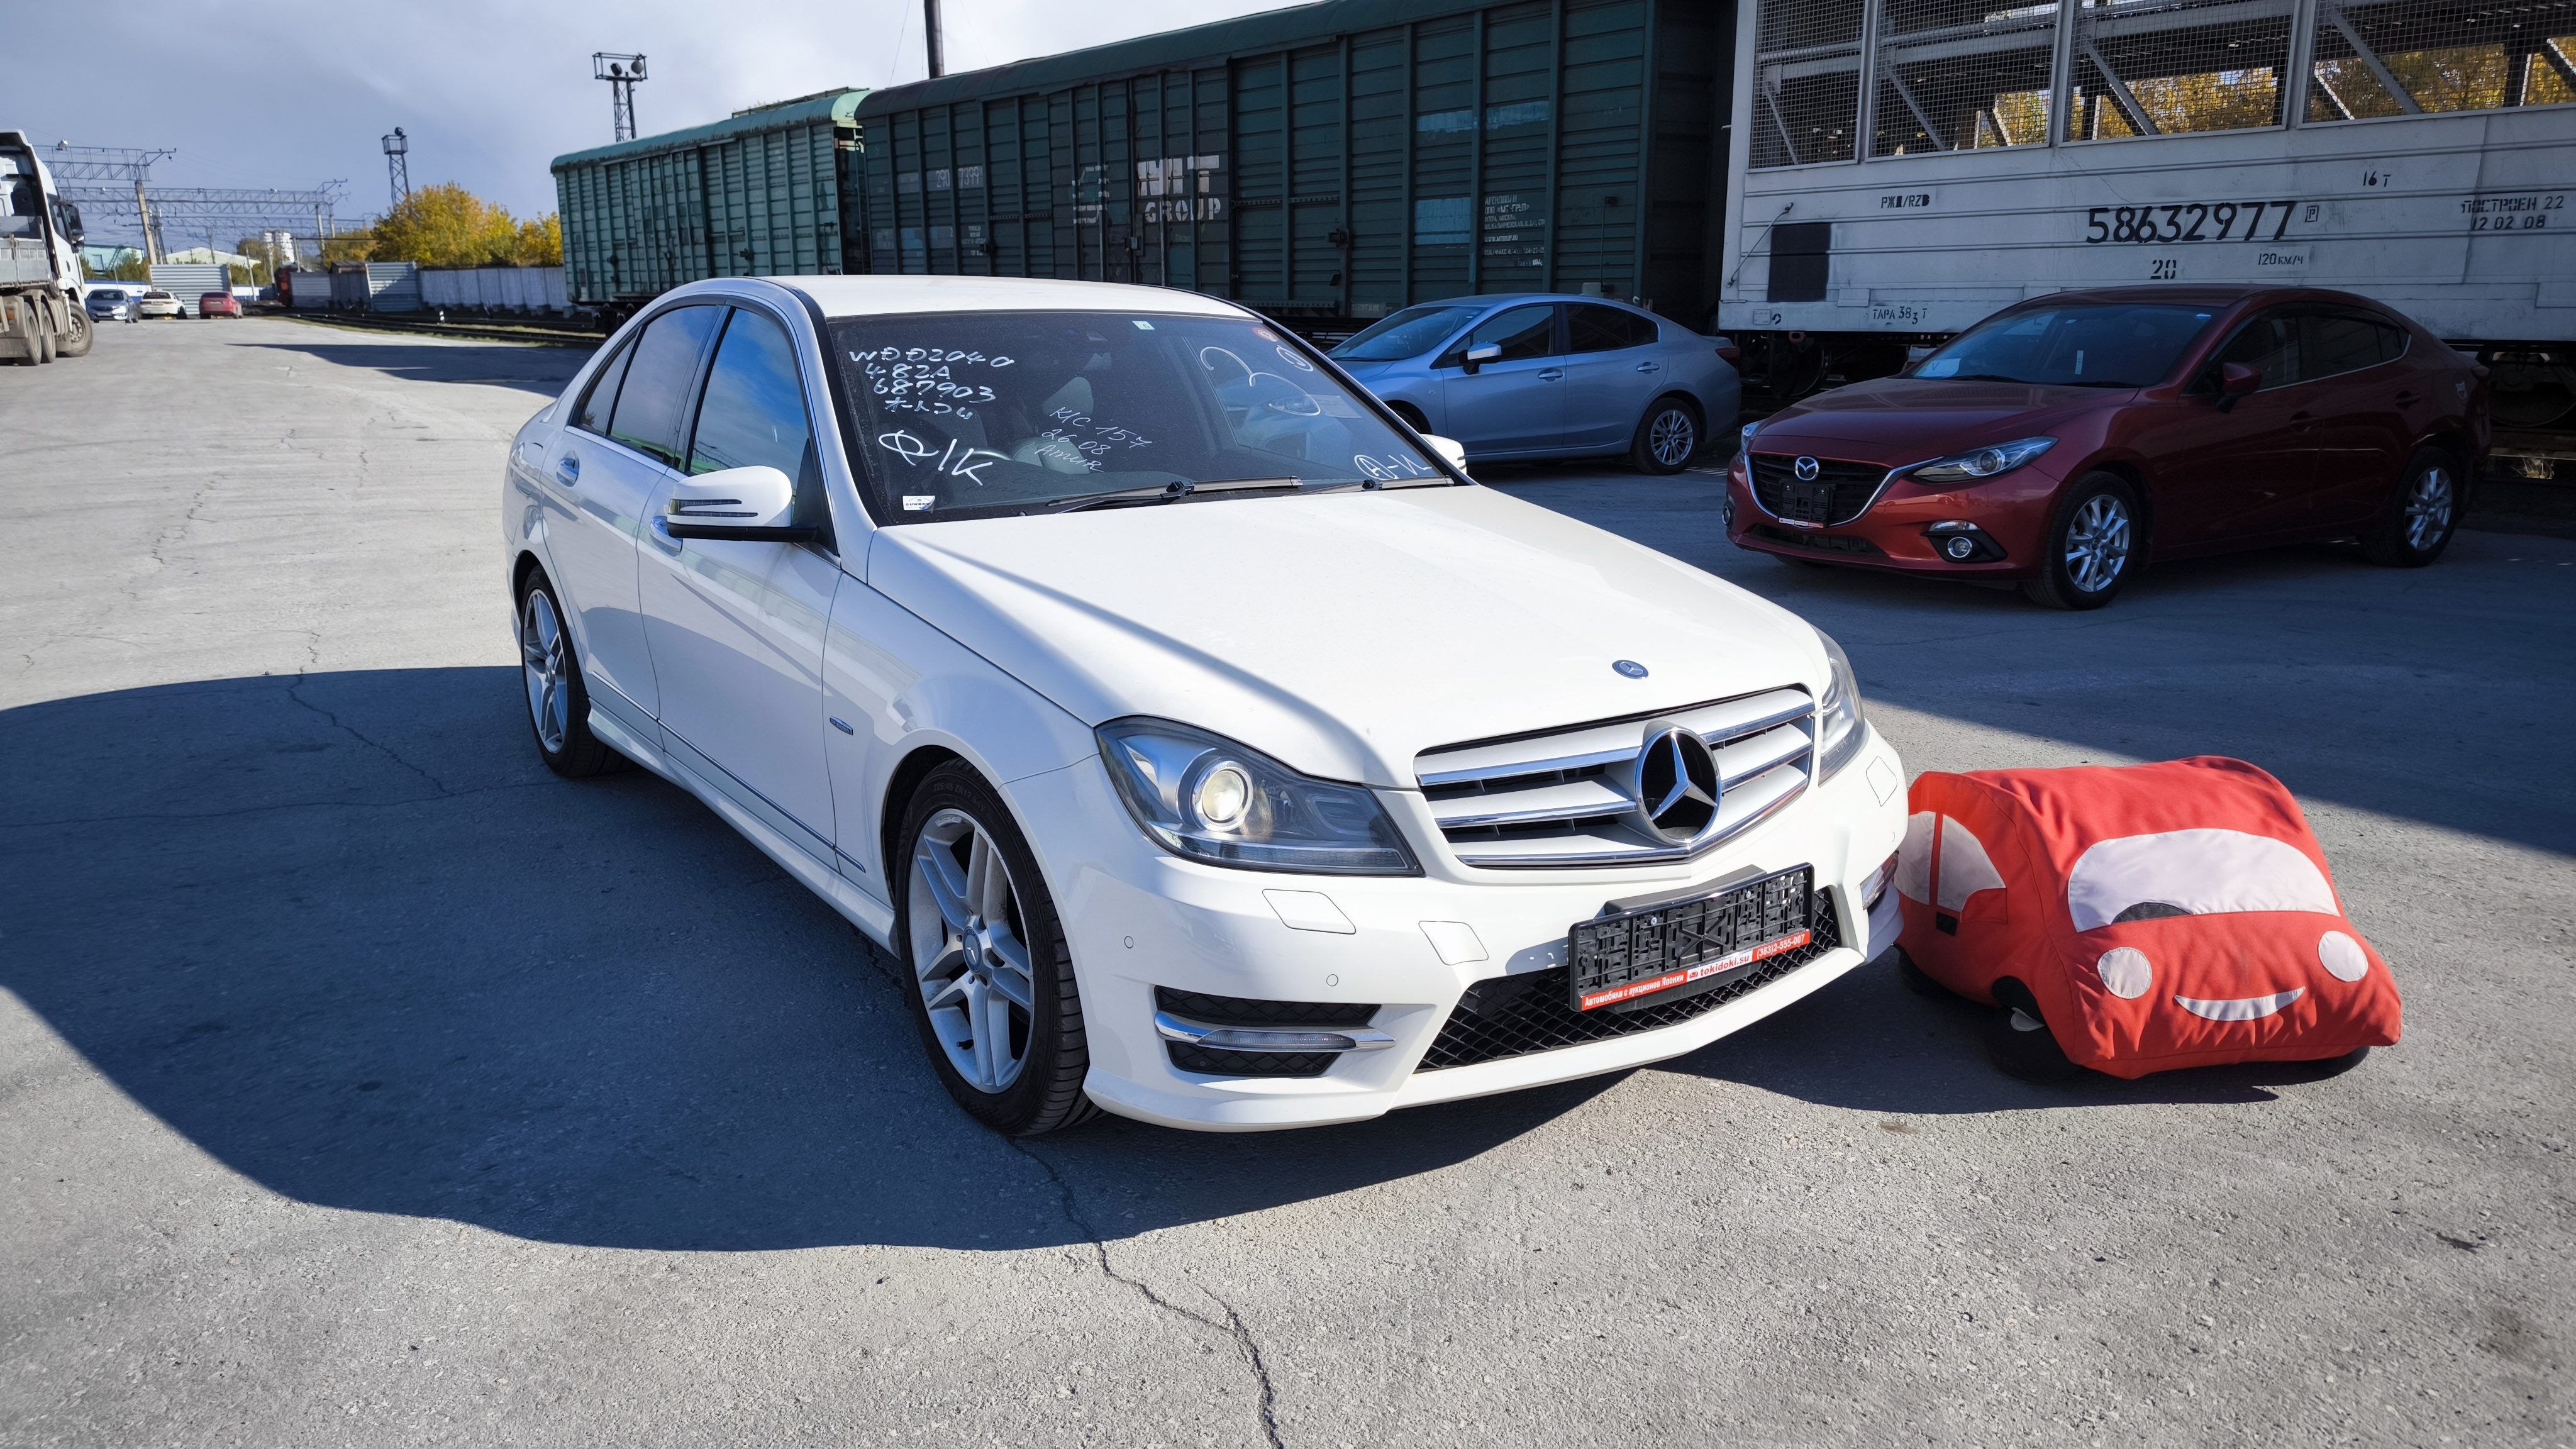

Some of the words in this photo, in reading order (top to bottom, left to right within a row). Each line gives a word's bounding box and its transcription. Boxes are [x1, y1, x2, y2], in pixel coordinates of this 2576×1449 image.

[1145, 198, 1221, 223] GROUP
[2544, 196, 2564, 209] 22
[2086, 201, 2297, 243] 58632977
[2472, 216, 2489, 230] 12
[2494, 216, 2514, 230] 02
[2524, 214, 2546, 229] 08
[2151, 259, 2177, 279] 20
[1873, 309, 1896, 319] ТАРА
[874, 378, 996, 403] 687903
[1757, 934, 1805, 960] (383)2-555-007
[1701, 955, 1750, 977] tokidoki.su
[1585, 991, 1623, 1007] Автомобили
[1624, 989, 1628, 997] с
[1628, 981, 1661, 997] аукционов
[1662, 974, 1685, 987] Японии
